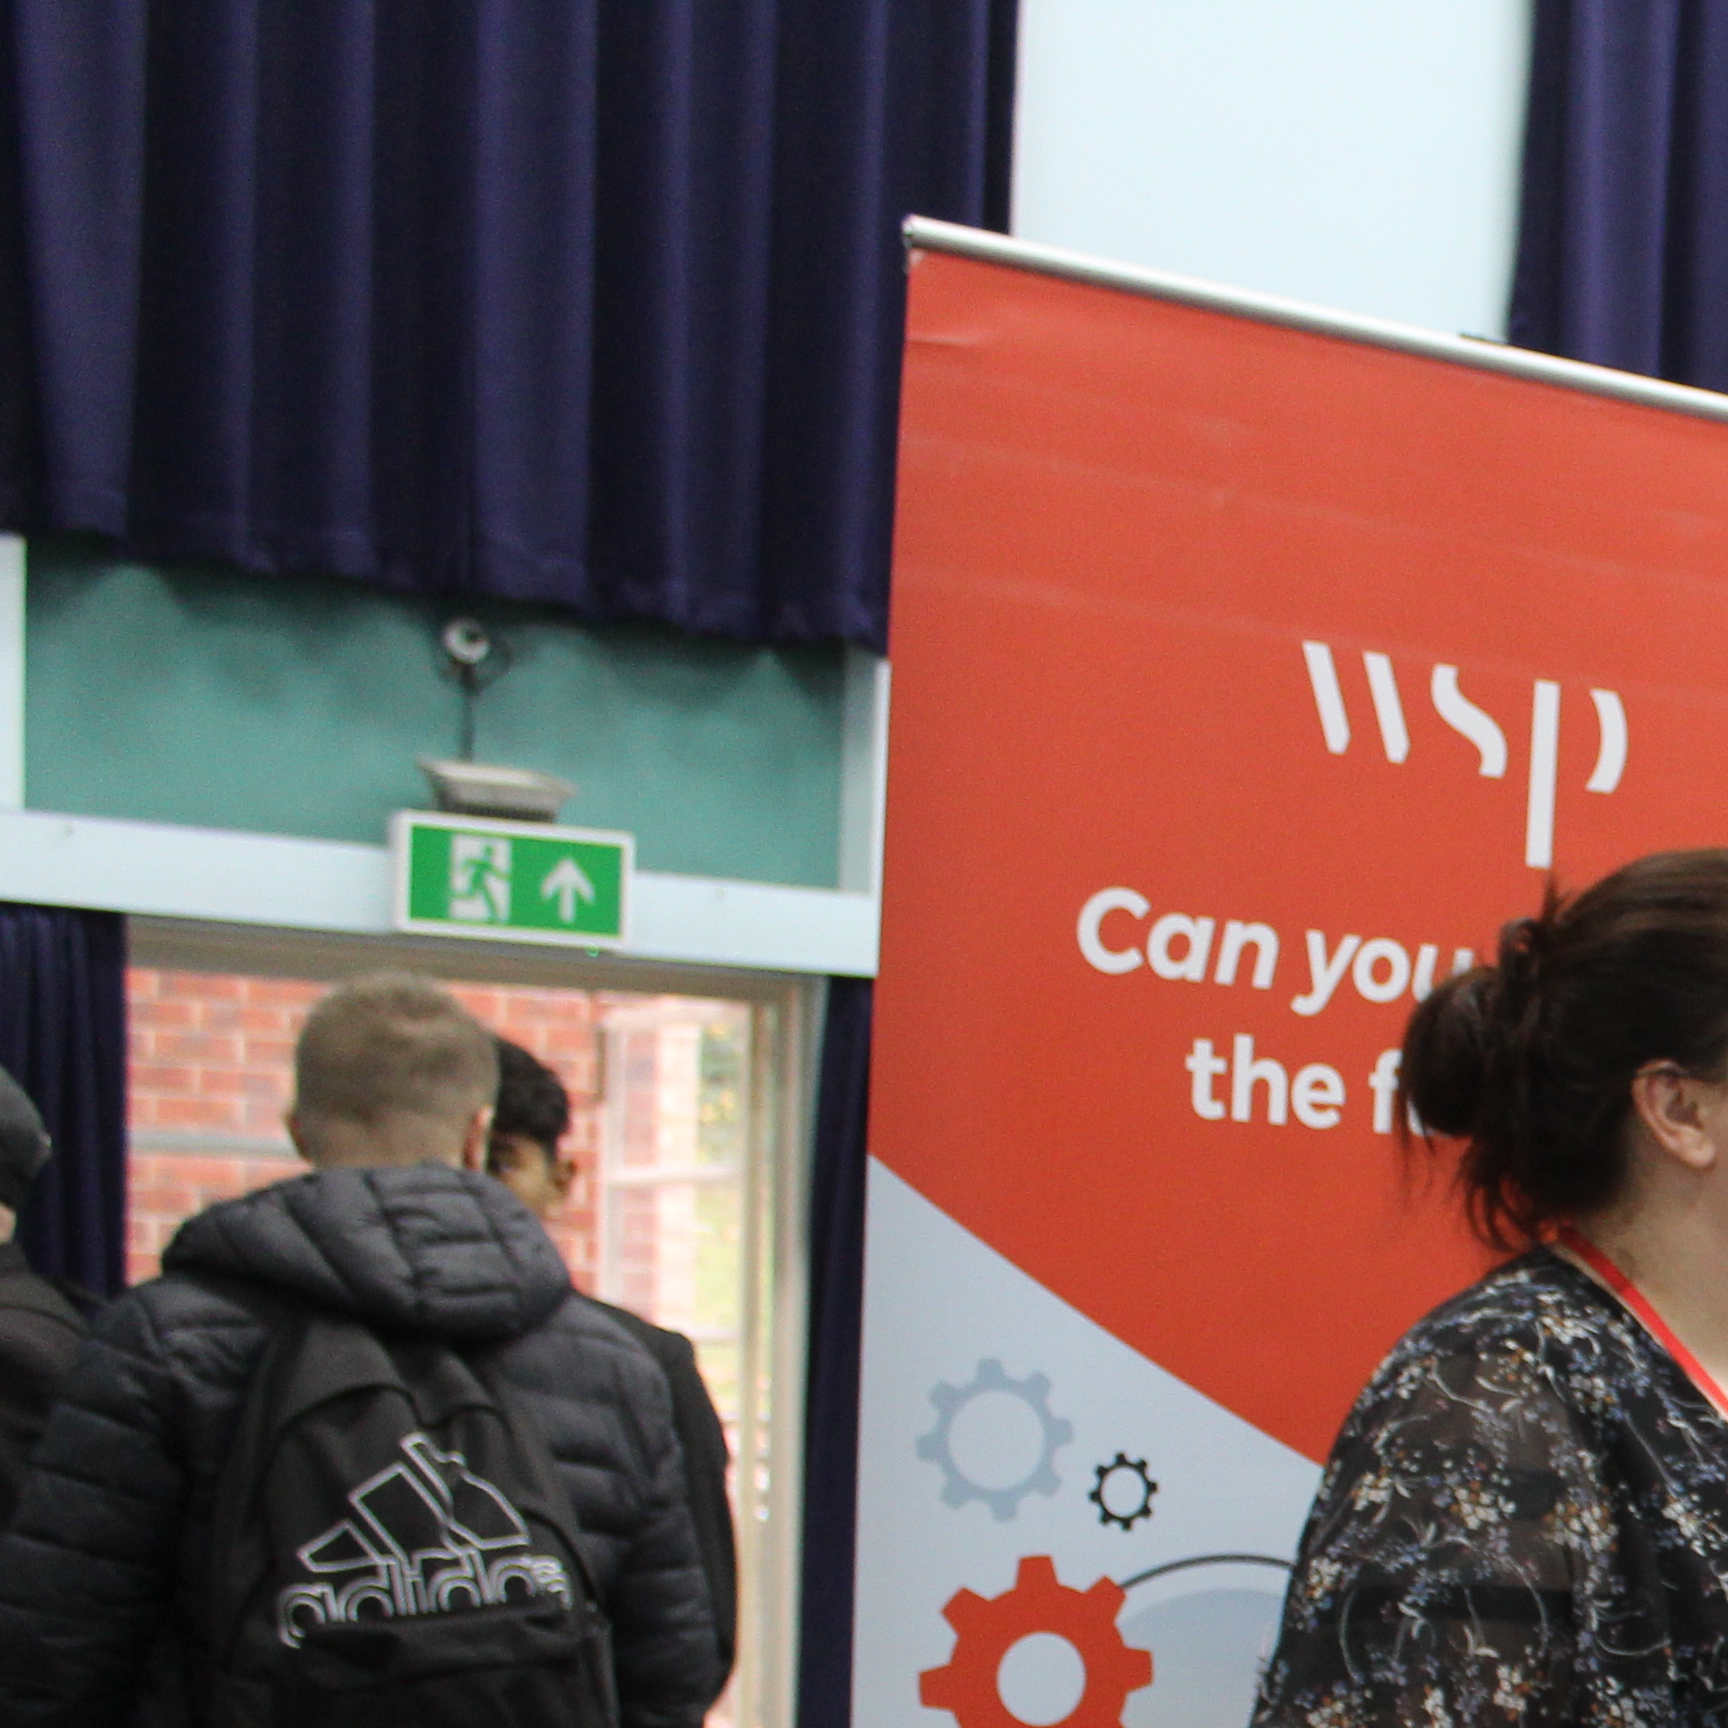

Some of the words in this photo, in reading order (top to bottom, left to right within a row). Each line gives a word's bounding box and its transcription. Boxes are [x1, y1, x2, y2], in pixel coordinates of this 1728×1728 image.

[1302, 640, 1628, 869] wsp
[1076, 887, 1280, 989] Can
[1185, 1034, 1346, 1129] the
